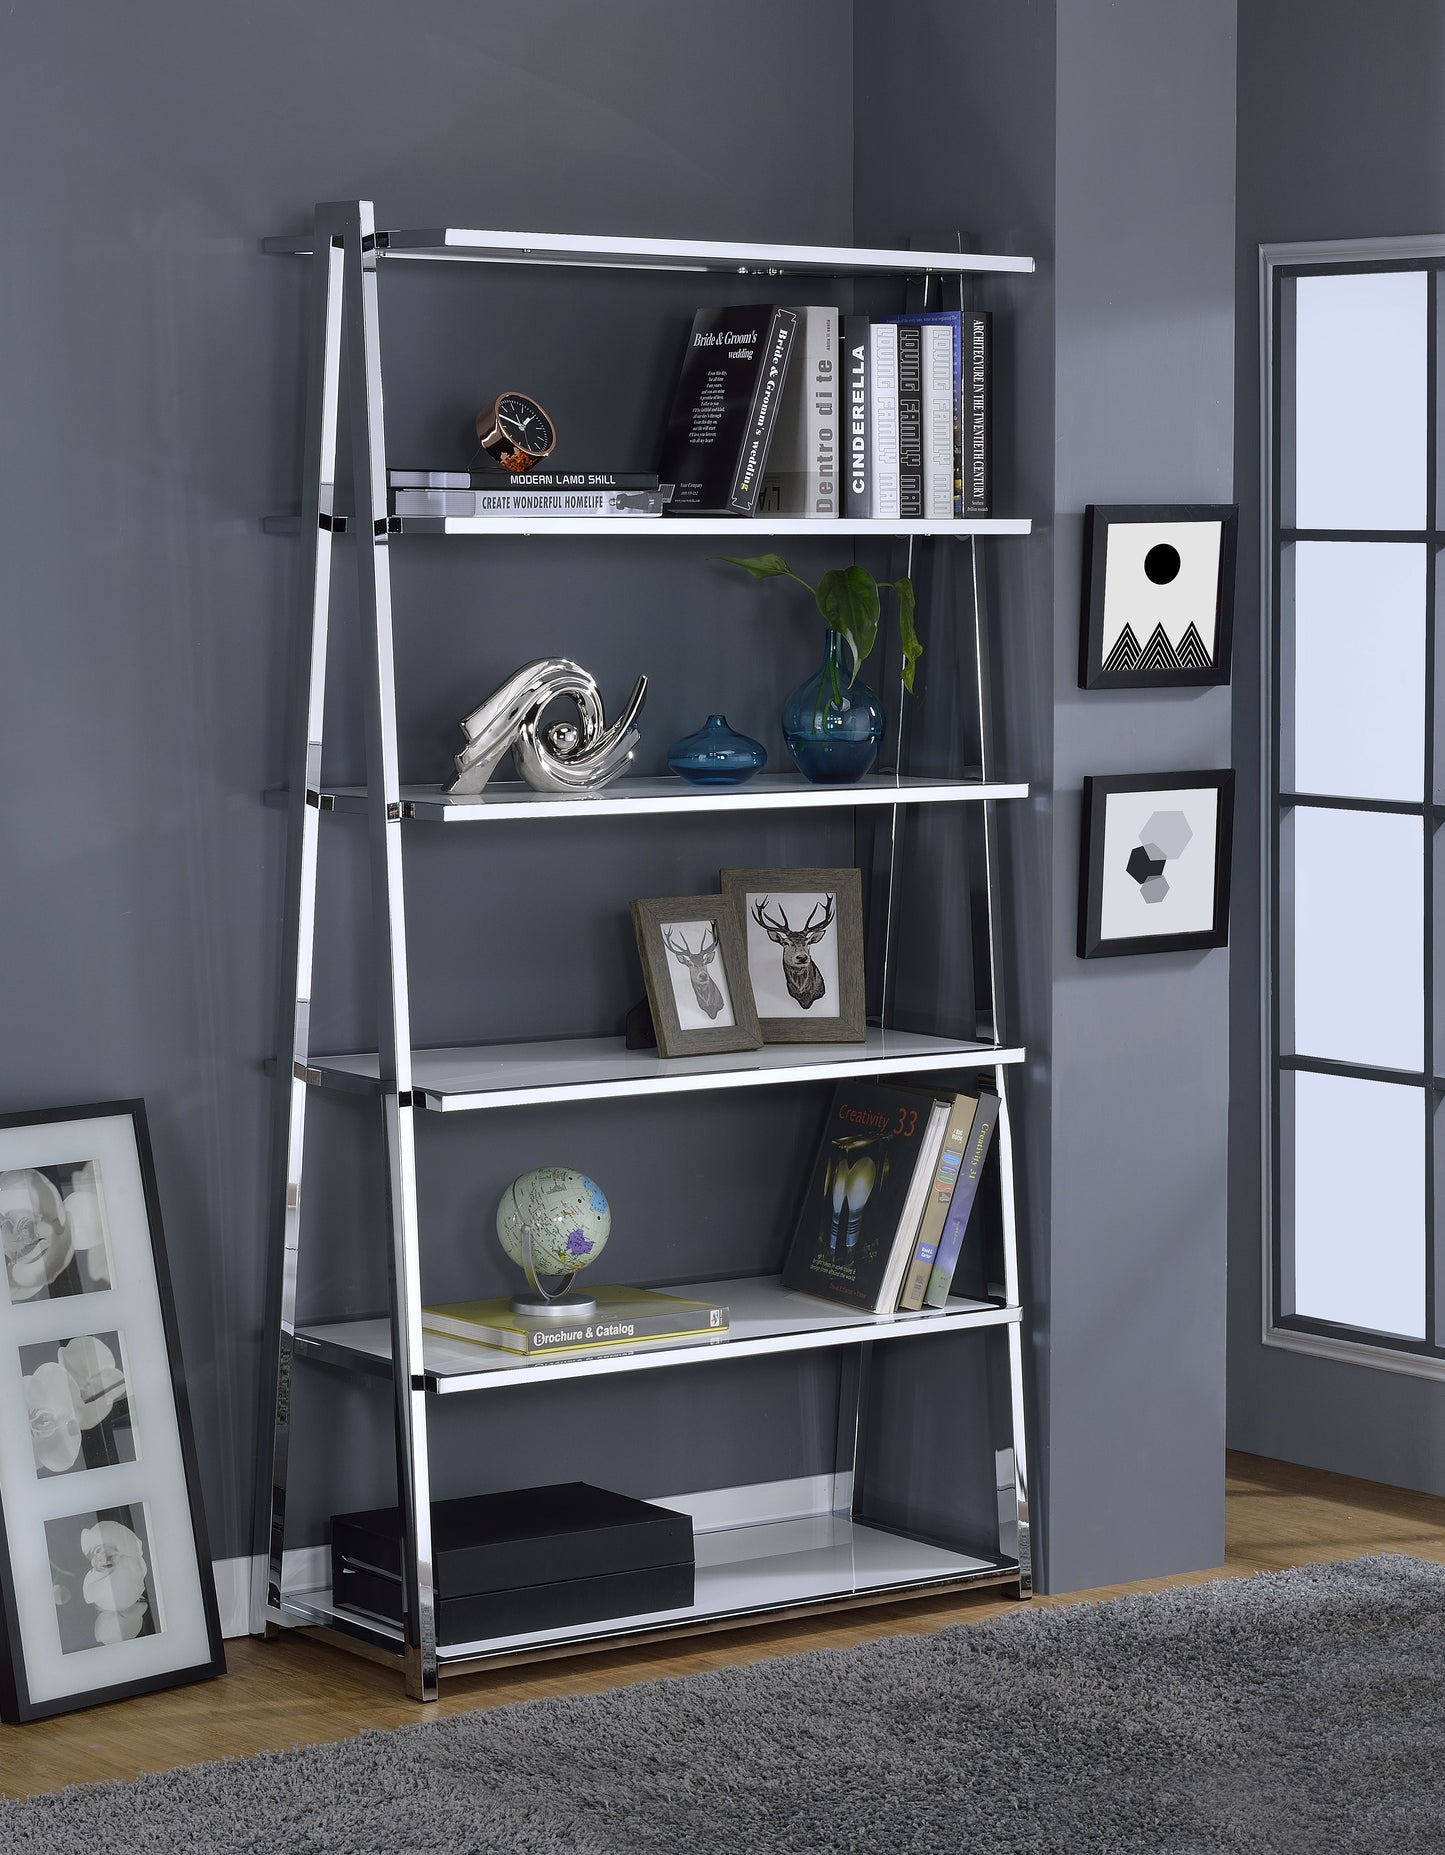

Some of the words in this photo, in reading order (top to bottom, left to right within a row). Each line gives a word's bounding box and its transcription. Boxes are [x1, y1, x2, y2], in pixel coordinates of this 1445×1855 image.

[693, 332, 716, 347] Bride
[716, 332, 724, 345] &
[724, 330, 758, 345] Groom's
[772, 328, 788, 365] Bride
[728, 348, 754, 361] wedding
[769, 365, 779, 378] &
[973, 383, 985, 394] IN
[973, 394, 985, 411] THE
[852, 345, 865, 494] CINDERELLA
[973, 412, 985, 460] TWENTIETH
[510, 474, 554, 485] MODERN
[556, 474, 585, 485] LAMO
[588, 474, 616, 485] SKILL
[740, 440, 760, 492] wedding
[816, 428, 834, 513] Dentro
[973, 461, 985, 499] CENTURY
[482, 496, 511, 510] CREATE
[513, 495, 562, 510] WONDERFUL
[565, 495, 603, 509] HOMELIFE
[839, 1104, 889, 1132] Creativity
[893, 1107, 918, 1137] 33
[971, 1123, 989, 1167] Creativity
[533, 1329, 583, 1347] Brochure
[585, 1327, 593, 1339] &
[596, 1323, 635, 1337] Catalog
